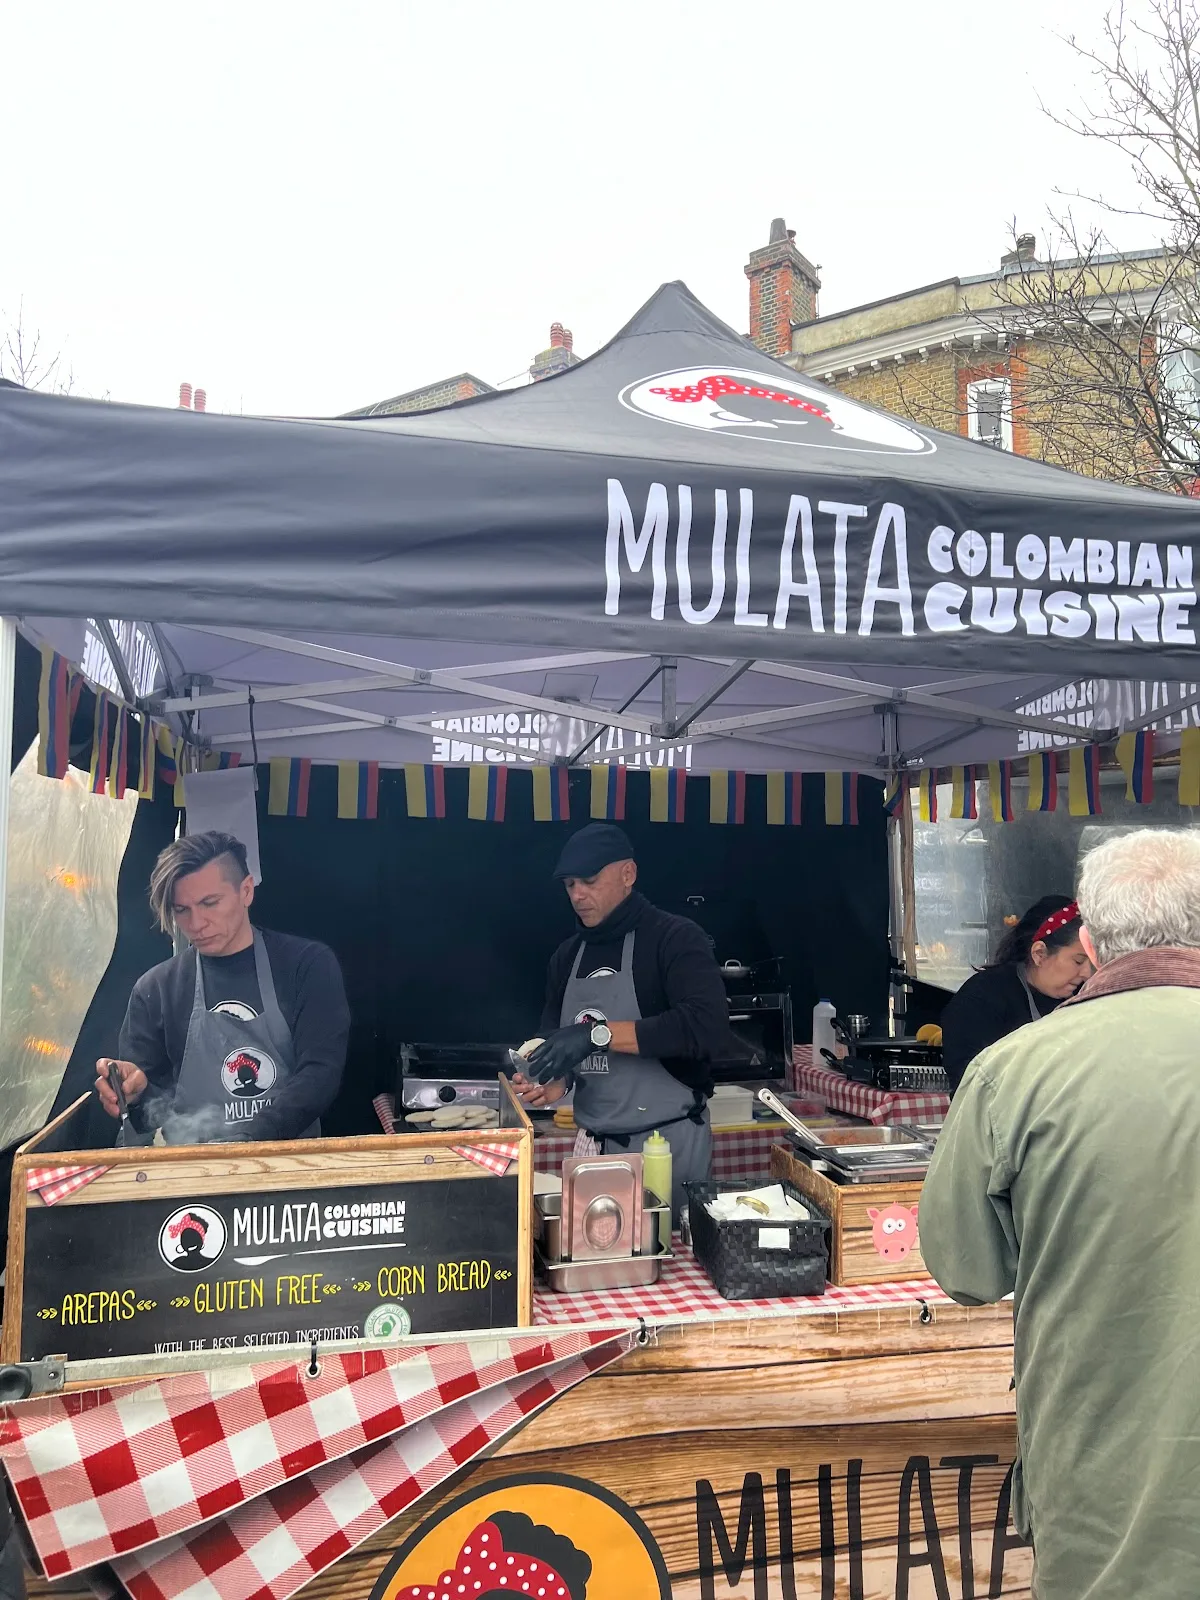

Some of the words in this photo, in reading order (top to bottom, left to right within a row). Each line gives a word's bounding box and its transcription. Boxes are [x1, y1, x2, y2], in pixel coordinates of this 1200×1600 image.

[604, 478, 917, 636] MULATA
[927, 525, 1195, 589] COLOMBIAN
[923, 581, 1197, 645] CUISINE
[233, 1202, 321, 1247] MULATA
[322, 1216, 405, 1238] CUISINE
[324, 1200, 406, 1220] COLOMBIAN
[61, 1289, 136, 1326] AREPAS
[194, 1277, 264, 1314] GLUTEN
[276, 1273, 324, 1306] FREE
[377, 1264, 425, 1298] CORN
[437, 1259, 491, 1293] BREAD
[154, 1340, 183, 1354] WITH
[189, 1338, 206, 1351] THE
[213, 1336, 238, 1350] BEST
[244, 1330, 289, 1347] SELECTED
[296, 1325, 359, 1343] INGREDIENTS
